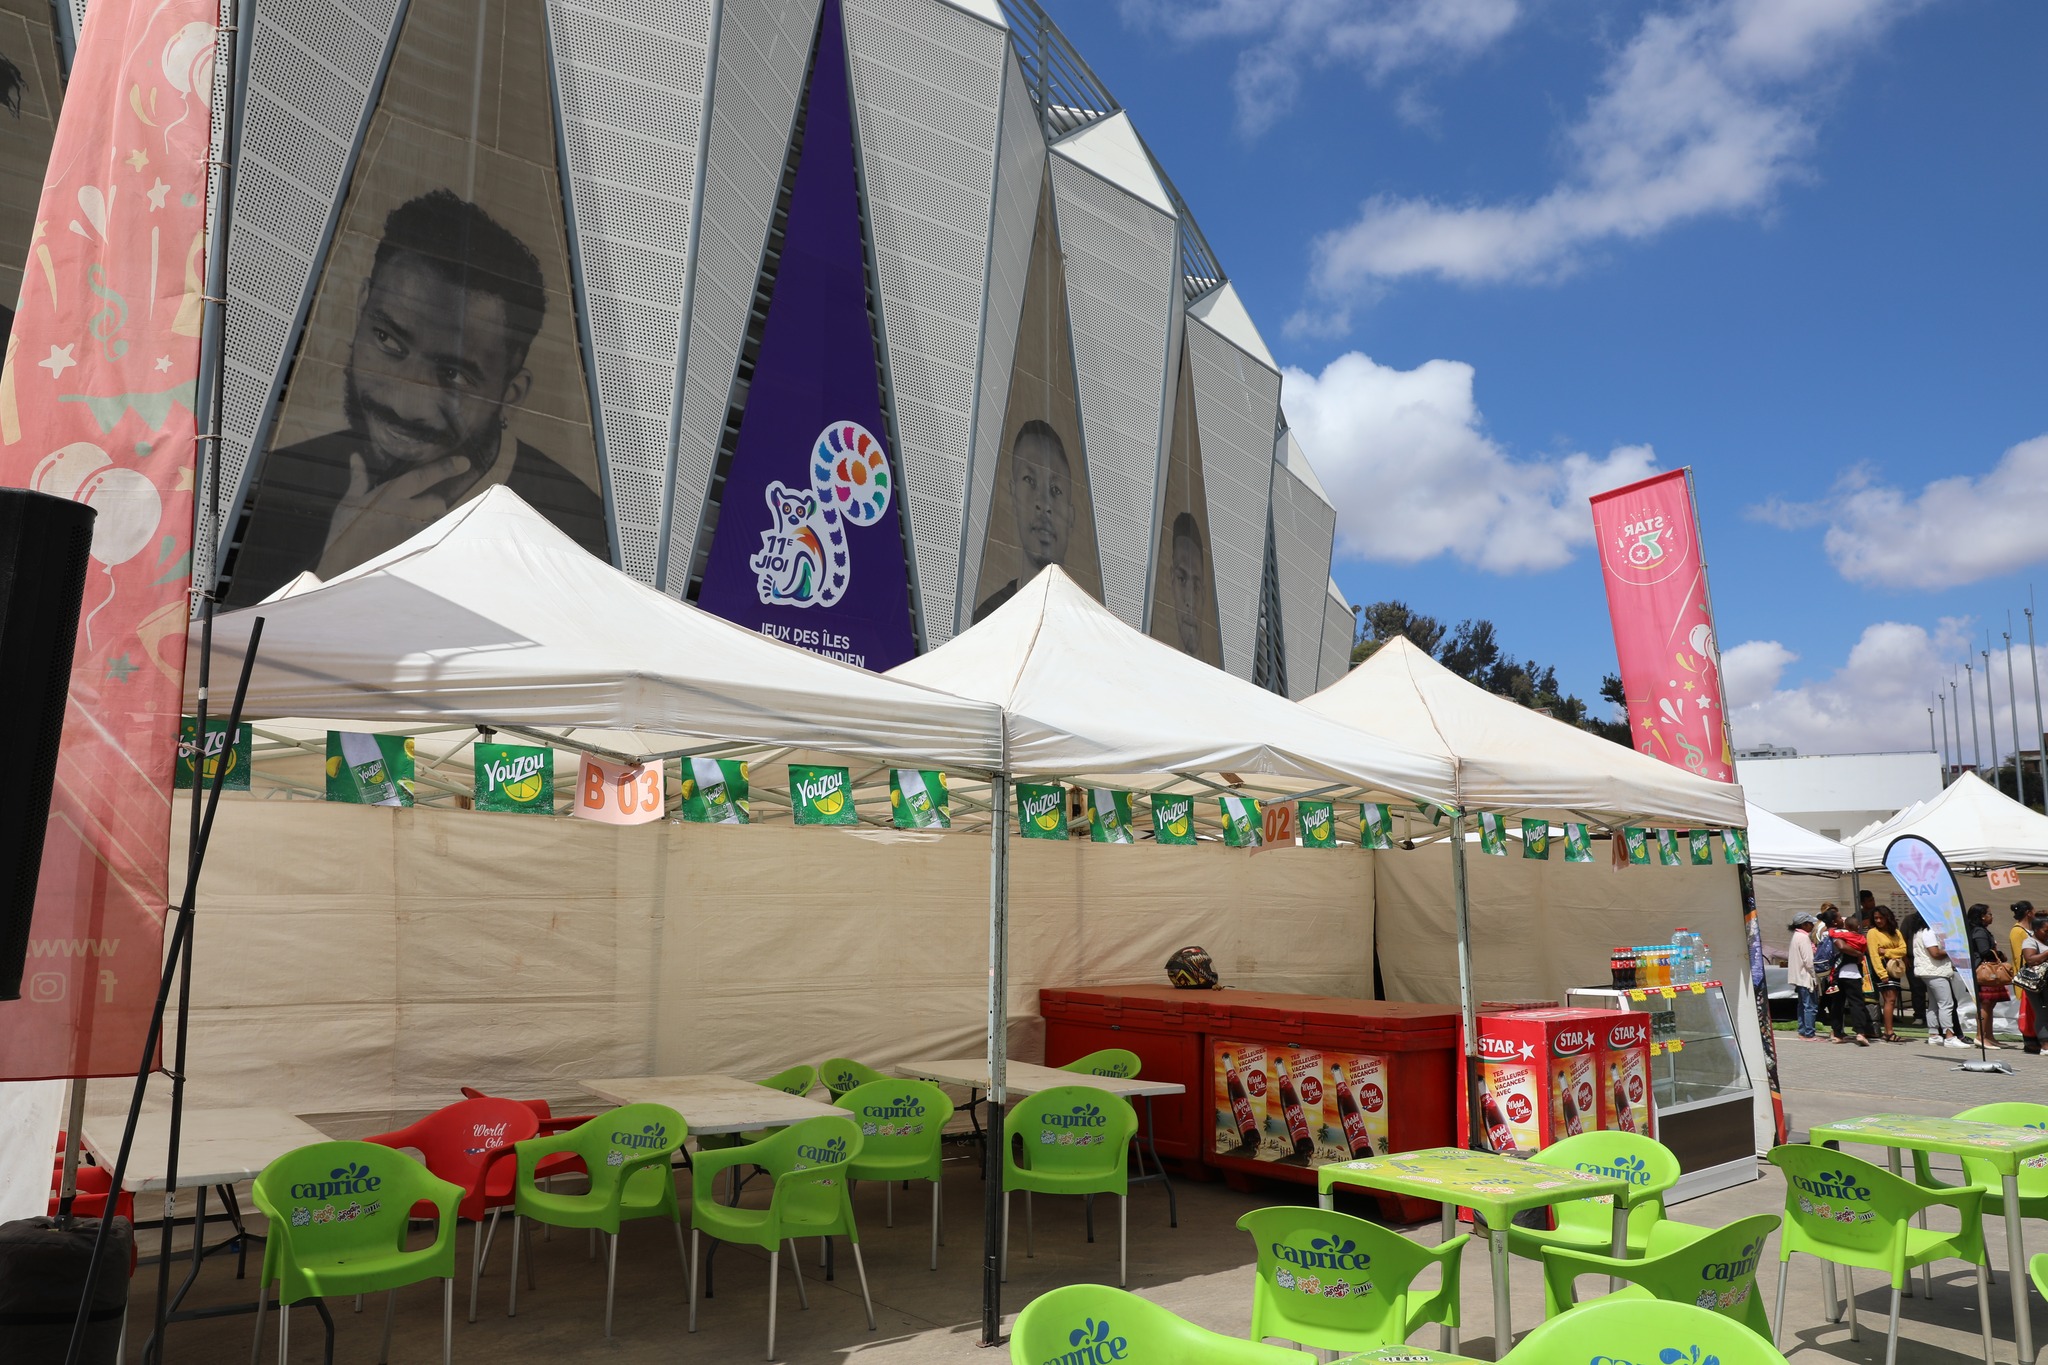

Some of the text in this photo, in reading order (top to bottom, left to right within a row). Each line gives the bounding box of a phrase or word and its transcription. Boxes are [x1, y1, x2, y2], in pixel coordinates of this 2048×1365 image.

[755, 555, 789, 572] JIOI
[794, 628, 819, 645] DES
[822, 629, 850, 650] ÎLES
[583, 762, 660, 815] B 03
[1265, 806, 1290, 843] 02
[1990, 869, 2019, 886] C 19
[1561, 1031, 1583, 1047] STAR
[1615, 1025, 1635, 1041] STAR
[1478, 1038, 1515, 1054] STAR
[1292, 1061, 1319, 1073] VACANCES
[1349, 1059, 1381, 1073] MEILLEURES
[1350, 1067, 1378, 1079] VACANCES
[1292, 1071, 1305, 1079] AVEC
[1351, 1078, 1364, 1086] AVEC
[1493, 1069, 1529, 1084] MEILLEURES
[1495, 1077, 1525, 1090] VACANCES
[1361, 1088, 1377, 1098] World
[1496, 1088, 1511, 1097] AVEC
[863, 1104, 925, 1120] caprice
[1507, 1099, 1525, 1110] World
[1515, 1106, 1531, 1117] Cola
[1041, 1112, 1107, 1128] caprice
[473, 1122, 507, 1136] World
[611, 1130, 668, 1149] caprice
[291, 1174, 382, 1200] caprice
[1793, 1174, 1871, 1202] caprice
[1271, 1242, 1371, 1271] caprice
